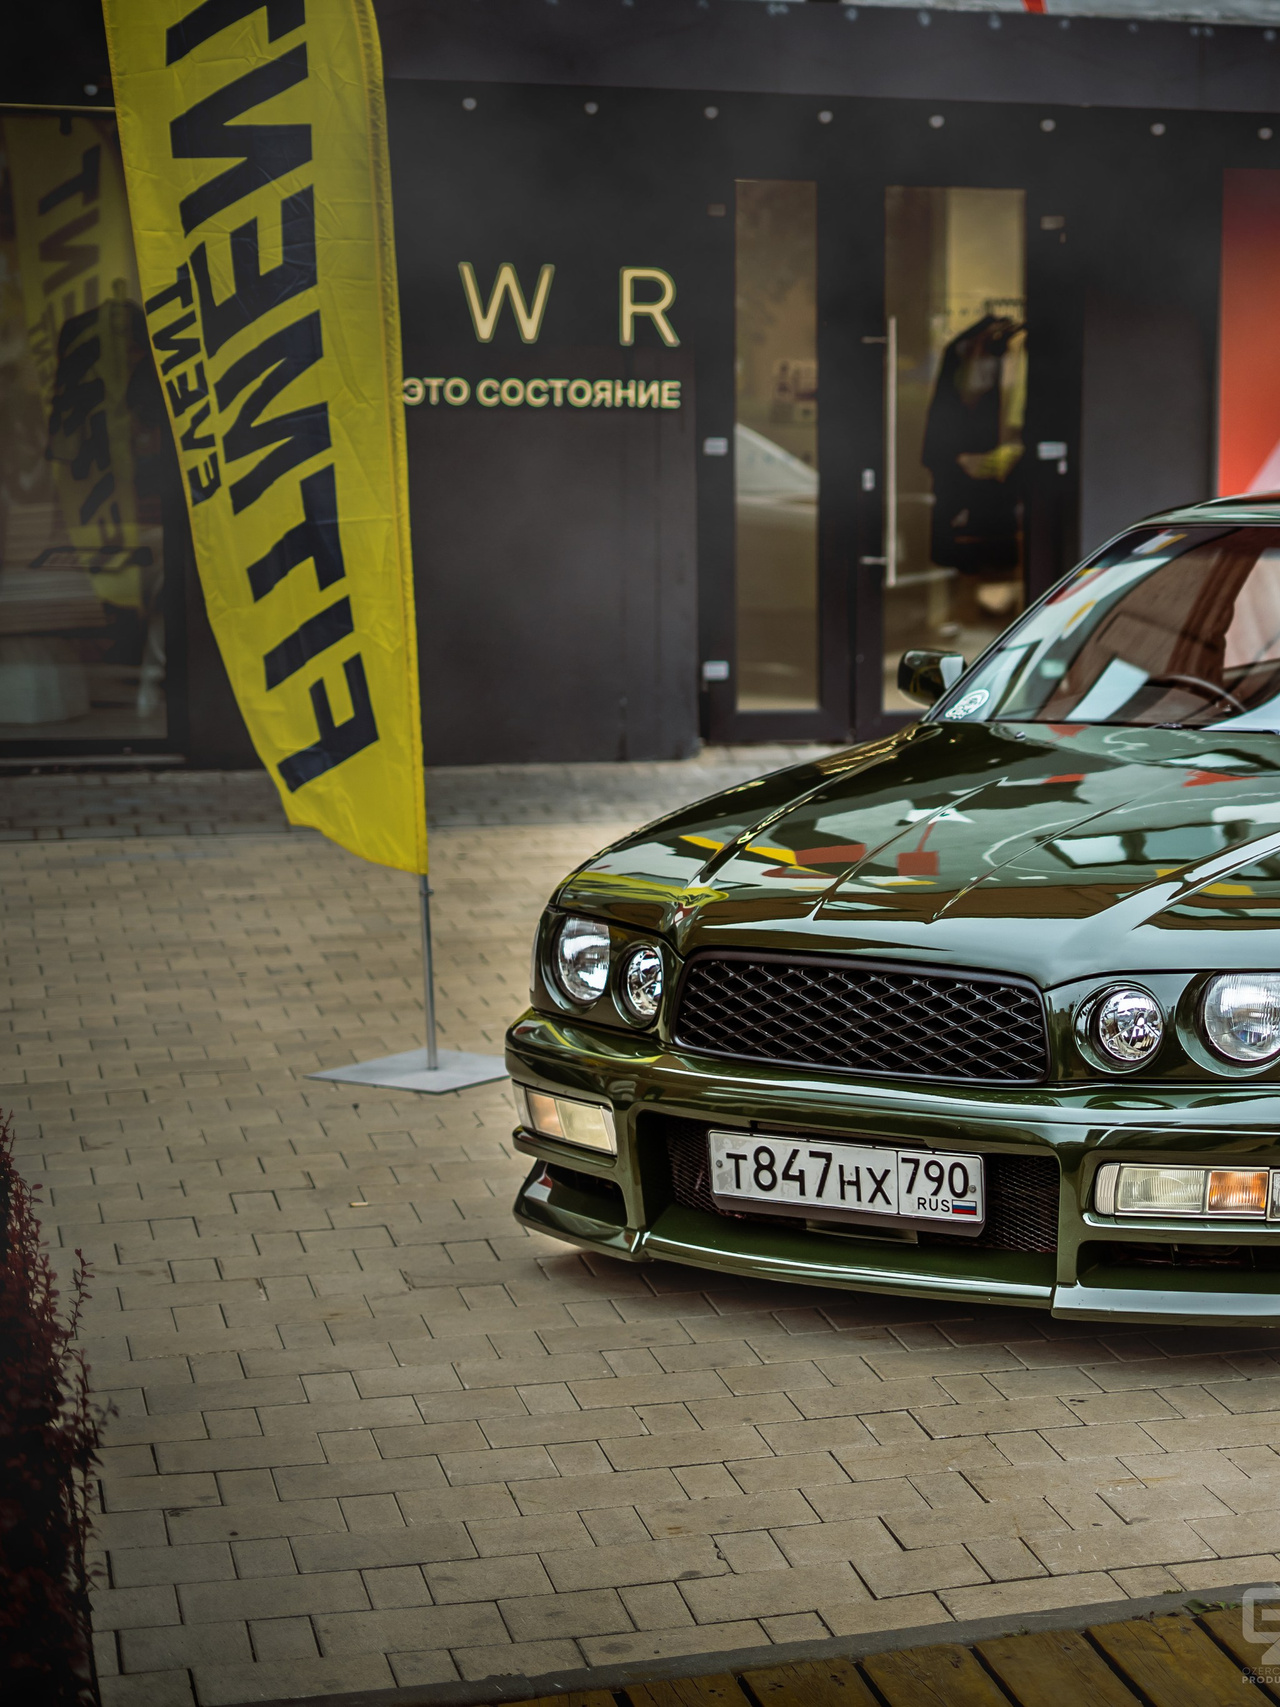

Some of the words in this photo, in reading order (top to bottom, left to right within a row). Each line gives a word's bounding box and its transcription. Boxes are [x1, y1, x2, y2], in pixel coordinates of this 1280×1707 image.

[402, 376, 471, 406] ЭТО
[475, 376, 681, 410] СОСТОЯНИЕ
[901, 1157, 970, 1198] 790
[917, 1197, 951, 1212] RUS
